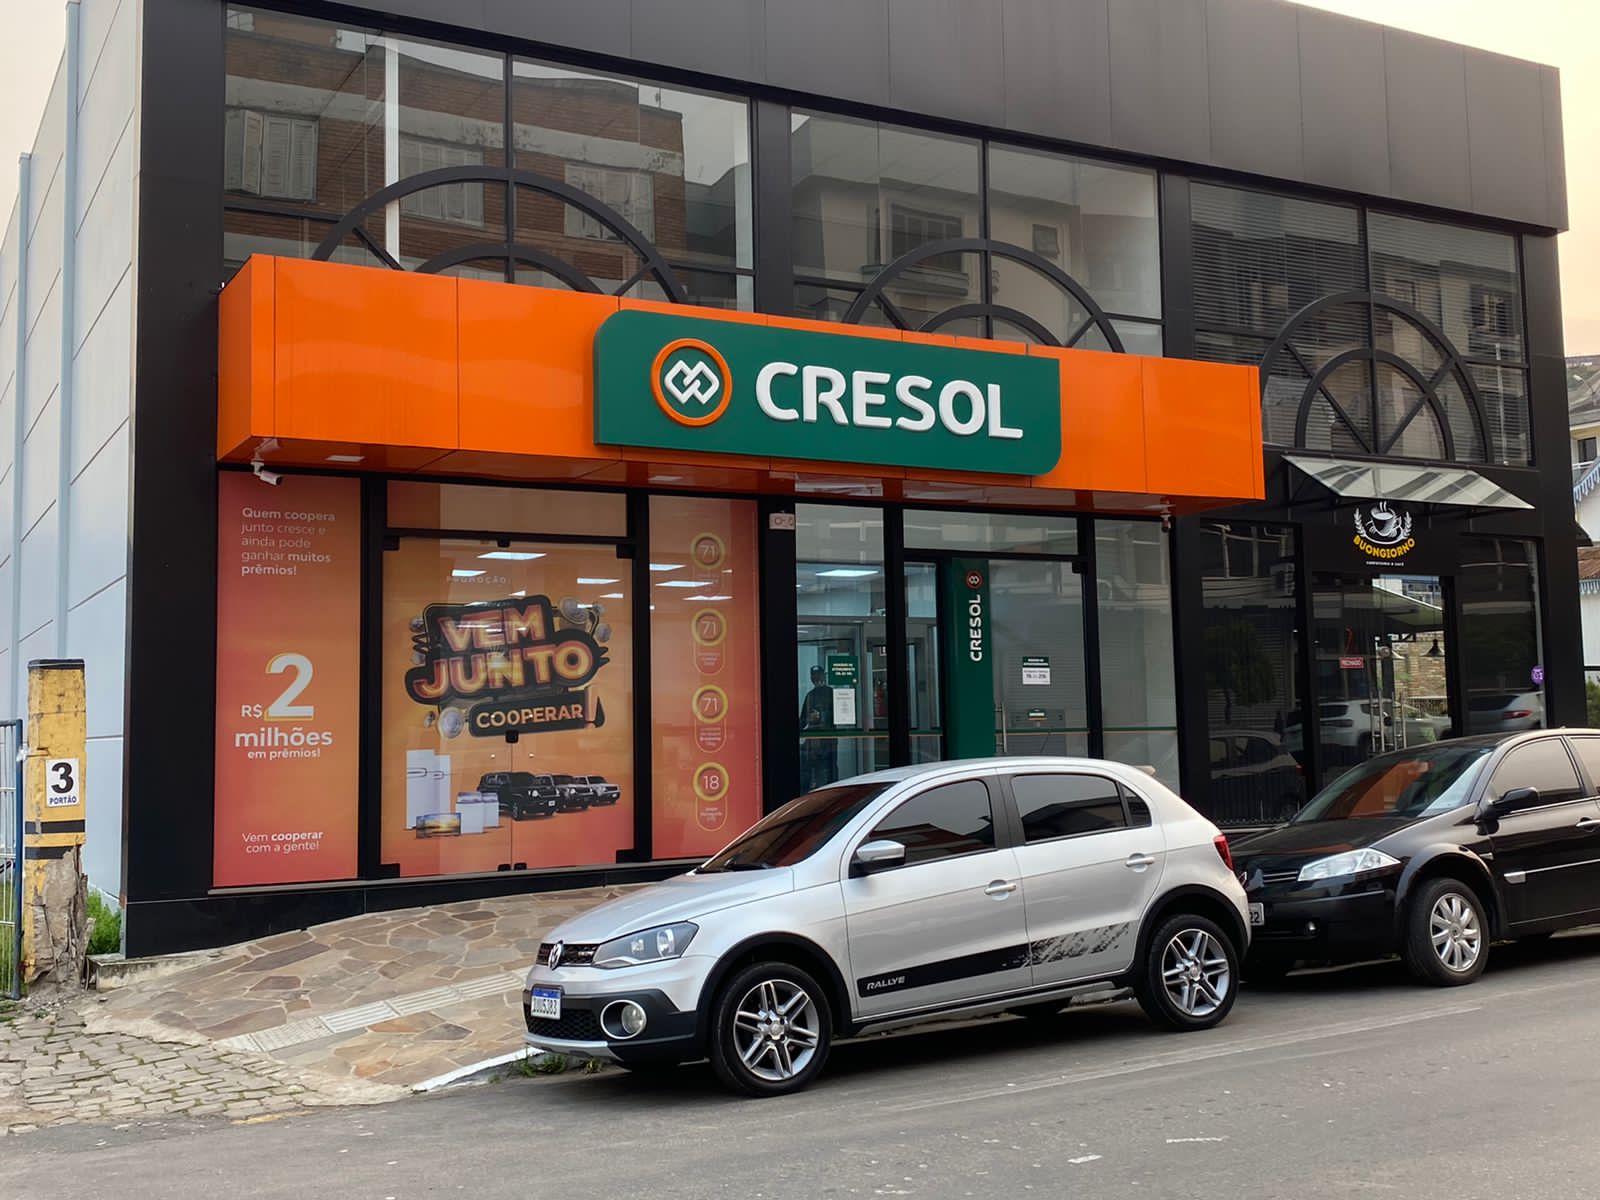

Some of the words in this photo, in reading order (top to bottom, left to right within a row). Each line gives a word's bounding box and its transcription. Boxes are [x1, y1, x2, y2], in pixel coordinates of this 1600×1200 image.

[755, 361, 1024, 439] CRESOL
[241, 507, 281, 519] Quem
[284, 510, 336, 522] coopera
[240, 522, 274, 535] junto
[277, 525, 315, 535] cresce
[318, 527, 327, 535] e
[241, 535, 275, 547] ainda
[279, 538, 311, 549] pode
[1352, 535, 1416, 559] BUONGIORNO
[241, 551, 284, 562] ganhar
[287, 550, 332, 562] muitos
[700, 545, 716, 559] 71
[241, 563, 298, 576] prêmios!
[437, 604, 546, 652] VEM
[701, 621, 717, 636] 71
[968, 594, 983, 662] CRESOL
[412, 640, 594, 699] JUNTO
[241, 704, 263, 719] R$
[264, 652, 315, 721] 2
[703, 698, 719, 713] 71
[476, 703, 584, 728] COOPERAR
[234, 727, 333, 748] milhões
[247, 750, 267, 759] em
[269, 748, 321, 760] prêmios!
[51, 762, 74, 794] 3
[703, 775, 720, 790] 18
[50, 795, 77, 804] PORTÃO
[242, 832, 268, 843] Vem
[271, 831, 324, 842] cooperar
[246, 844, 271, 853] com
[274, 844, 281, 852] a
[283, 841, 320, 854] gente!
[866, 975, 905, 990] RALLYE
